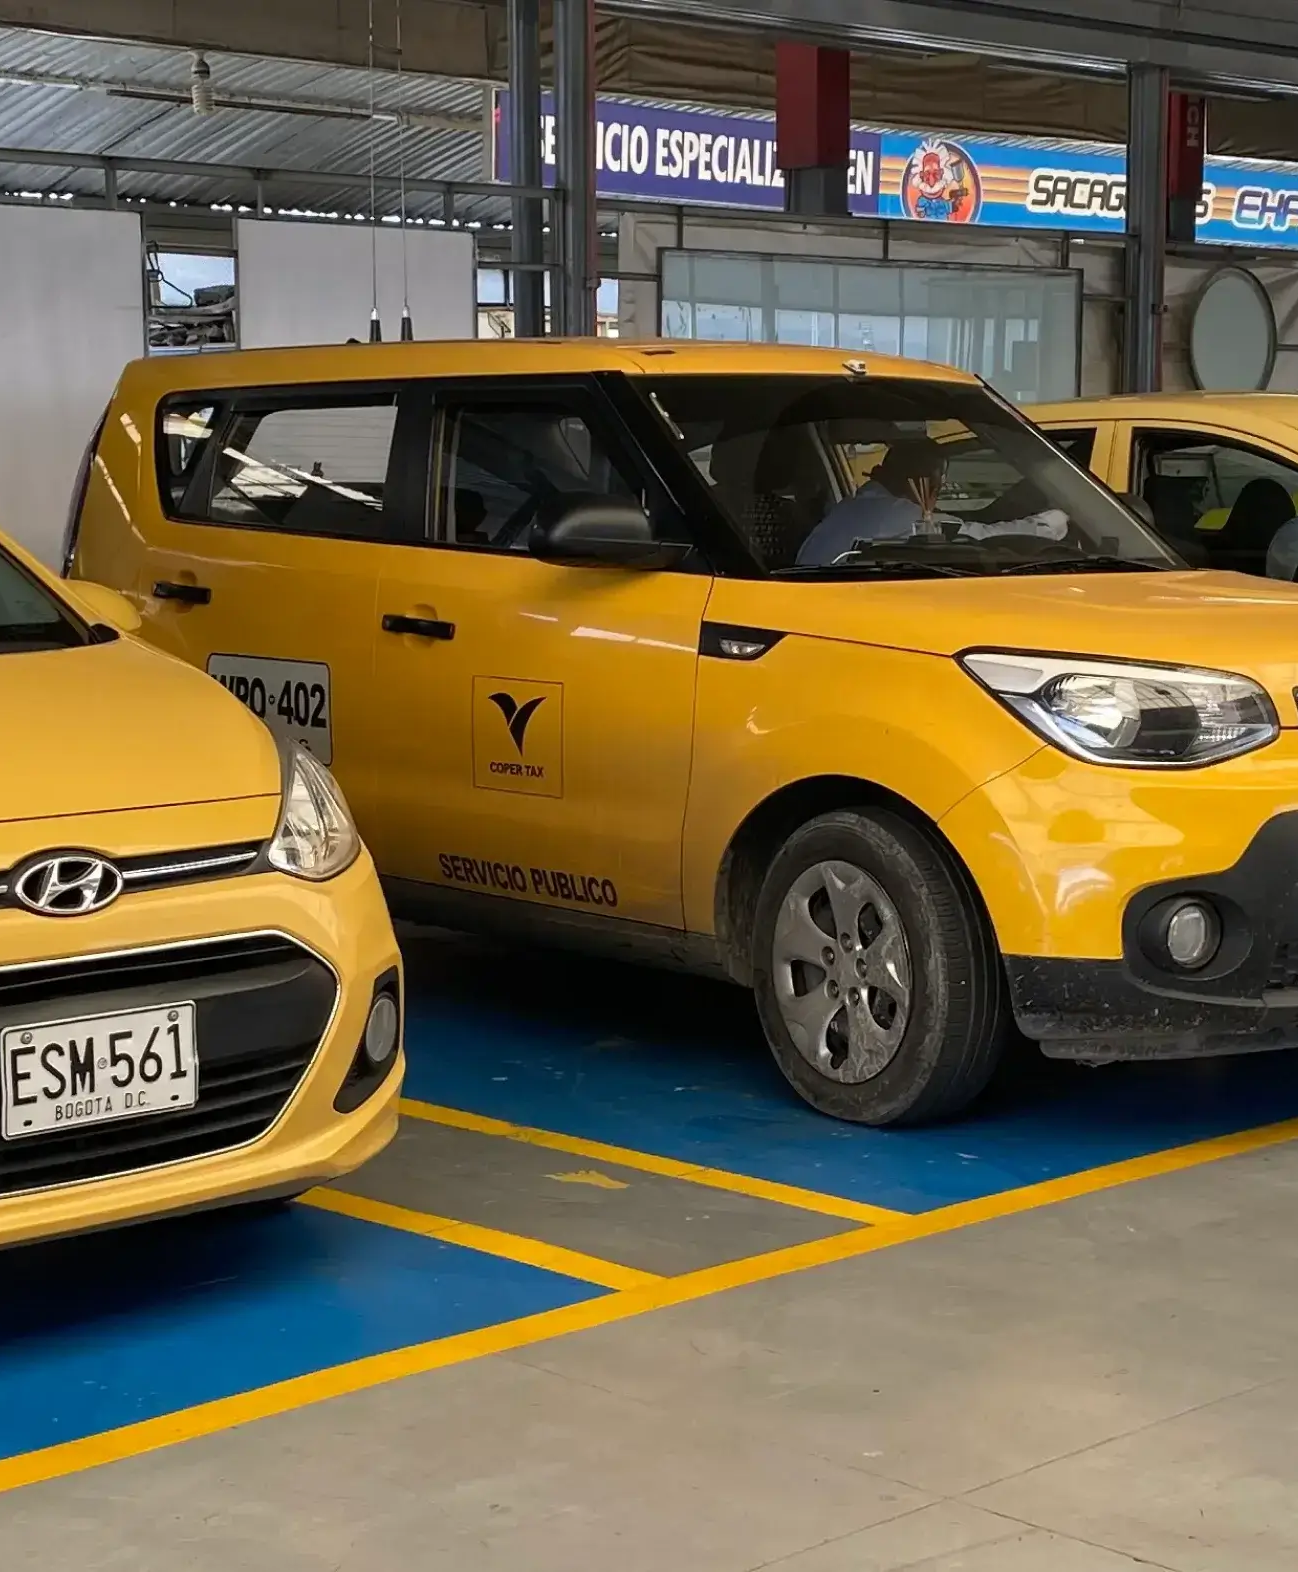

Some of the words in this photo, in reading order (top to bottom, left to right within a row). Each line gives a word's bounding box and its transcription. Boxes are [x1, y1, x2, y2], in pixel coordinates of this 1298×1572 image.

[540, 114, 650, 175] EICIO
[655, 127, 785, 188] ESPECIALIZ
[1030, 173, 1212, 219] SACAGS
[210, 674, 267, 719] PO
[489, 761, 523, 777] COPER
[524, 764, 545, 778] TAX
[438, 852, 528, 893] SERVICIO
[529, 867, 619, 908] PUBLICO
[55, 1095, 113, 1122] BOGOTA
